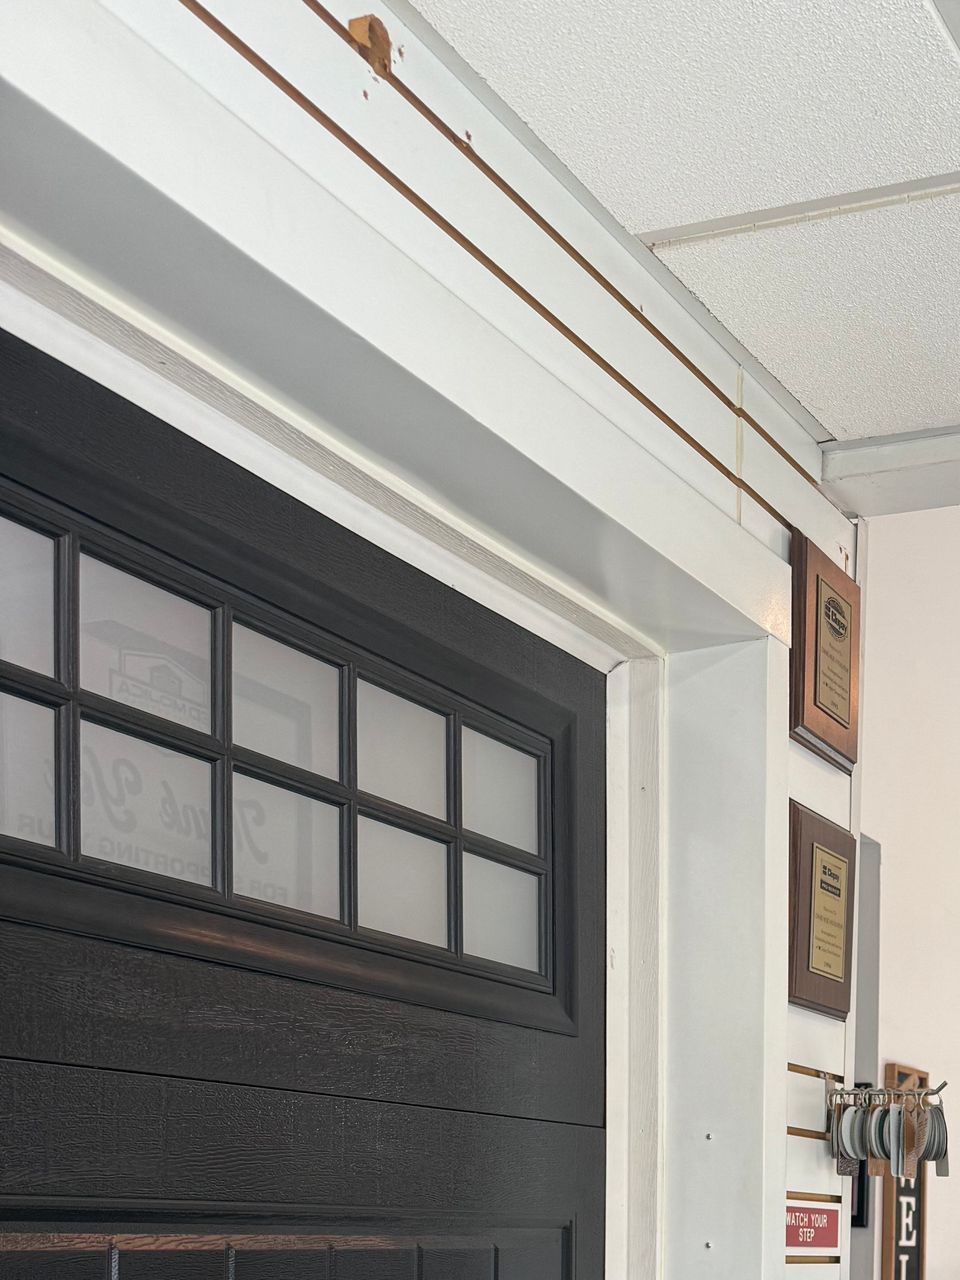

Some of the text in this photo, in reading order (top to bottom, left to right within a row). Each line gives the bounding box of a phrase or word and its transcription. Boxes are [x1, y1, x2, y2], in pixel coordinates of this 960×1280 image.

[786, 1212, 828, 1227] WATCH YOUR
[799, 1228, 815, 1242] STEP
